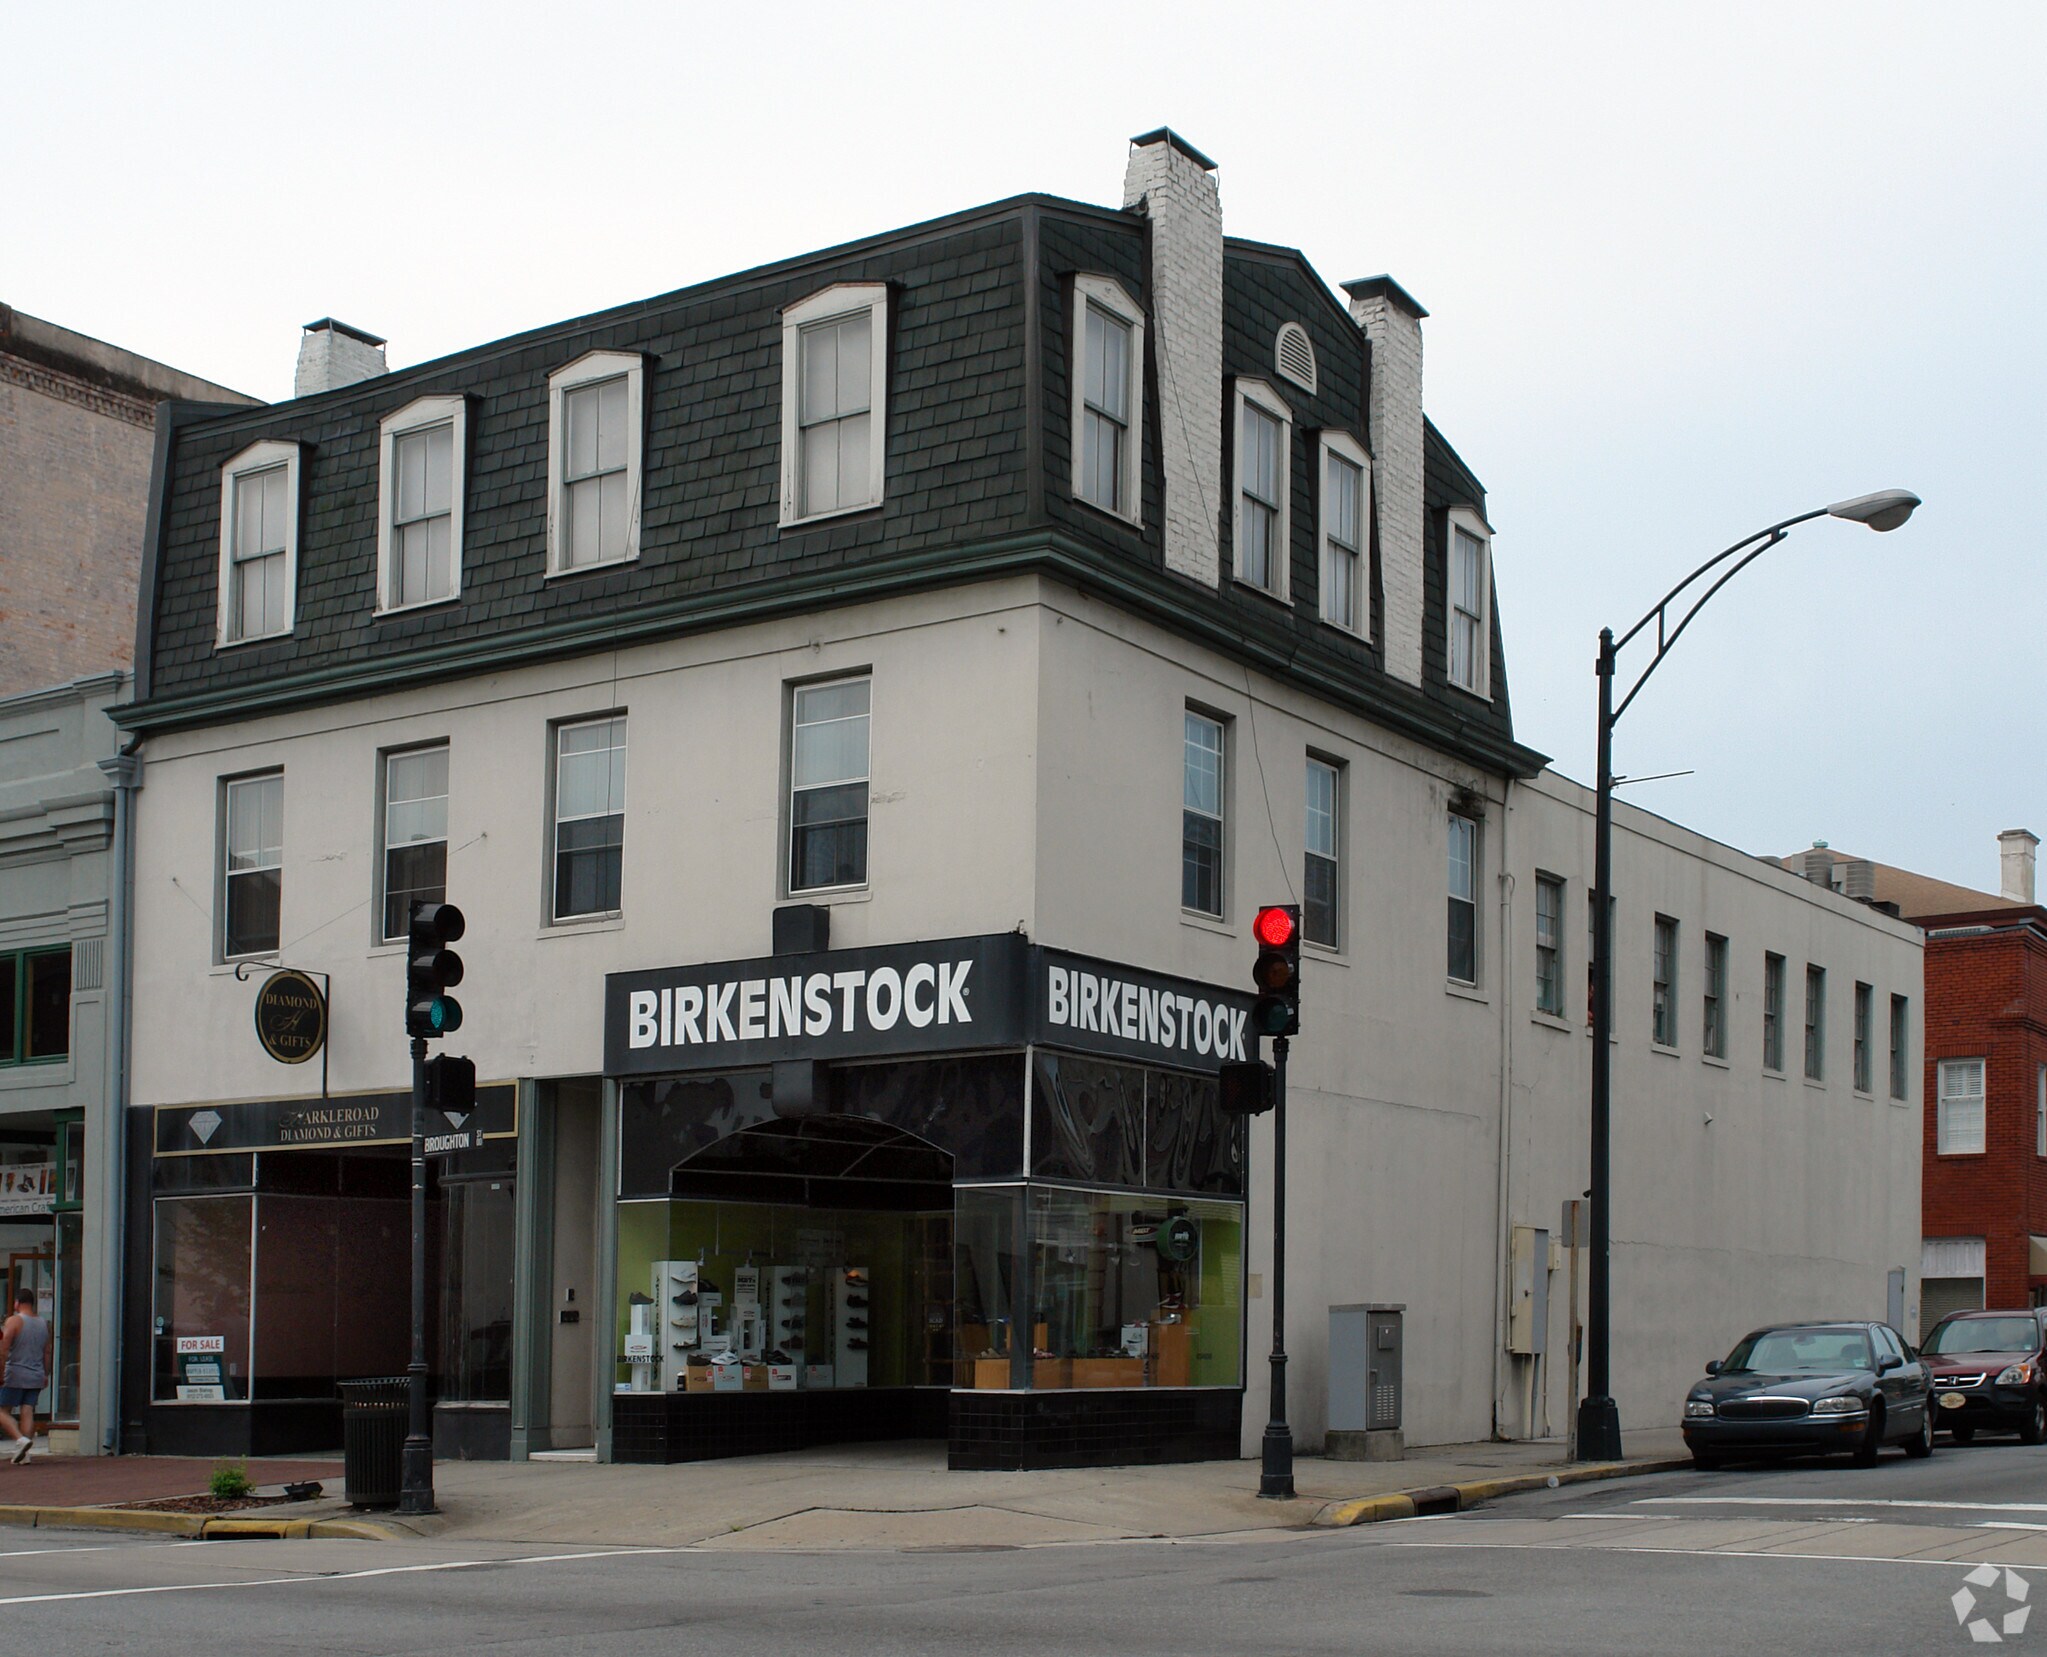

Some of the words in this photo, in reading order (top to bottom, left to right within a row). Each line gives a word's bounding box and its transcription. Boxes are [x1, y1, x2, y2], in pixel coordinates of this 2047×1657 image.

[266, 993, 317, 1009] DIAMOND
[629, 960, 973, 1049] BIRKENSTOCK
[1049, 965, 1247, 1062] BIRKENSTOCK
[269, 1034, 277, 1046] &
[281, 1035, 311, 1048] GIFTS
[281, 1127, 331, 1141] DIAMOND
[333, 1126, 341, 1139] &
[345, 1124, 376, 1138] GIFTS
[425, 1133, 469, 1152] BROUGHTON
[182, 1341, 197, 1349] FOR
[200, 1340, 220, 1349] SALE
[617, 1355, 664, 1363] BIRKENSTOCK
